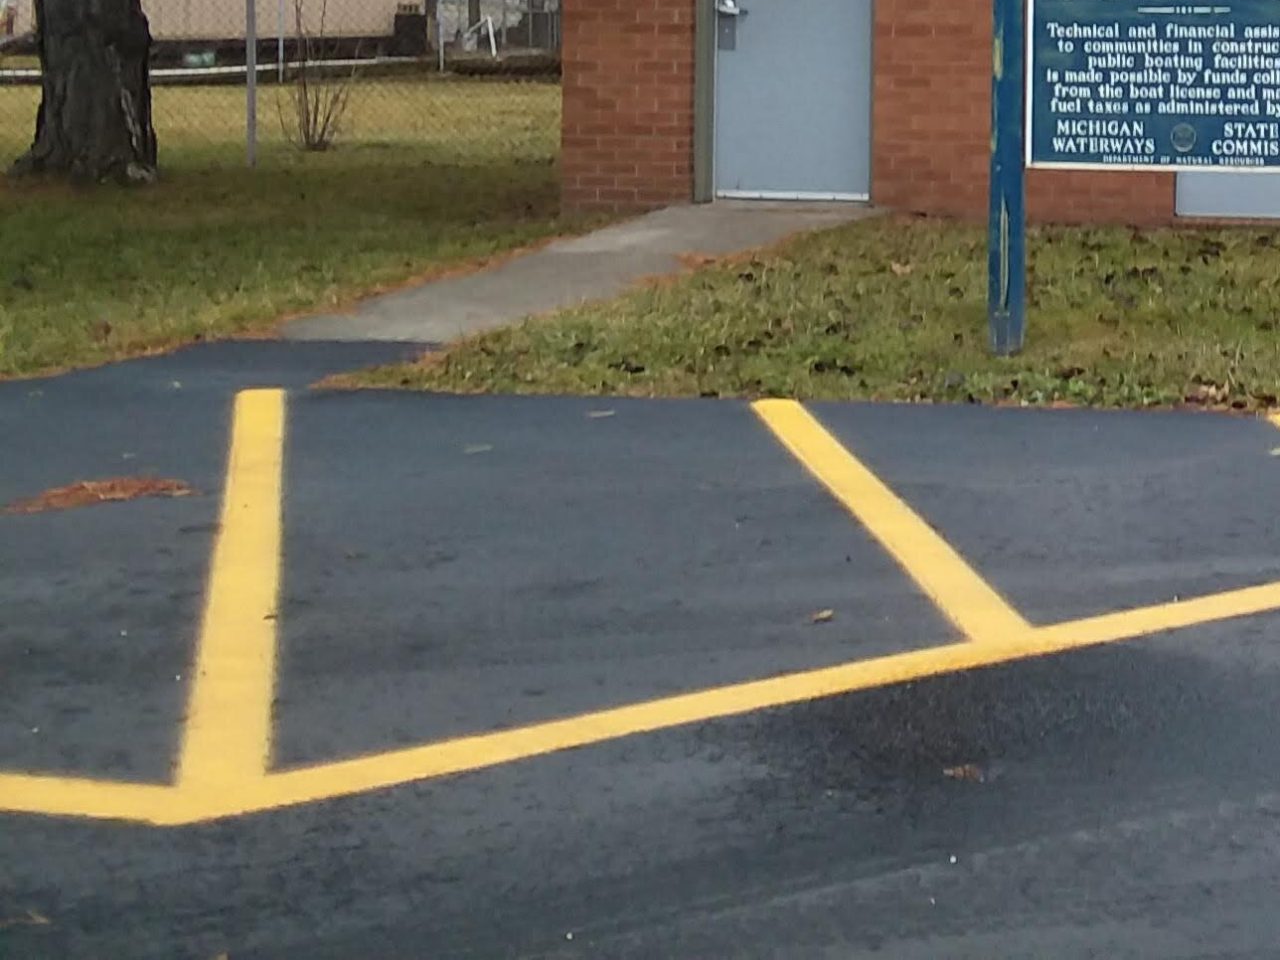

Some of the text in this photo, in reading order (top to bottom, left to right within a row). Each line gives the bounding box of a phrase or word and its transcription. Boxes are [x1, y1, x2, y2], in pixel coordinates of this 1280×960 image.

[1046, 23, 1119, 38] Technical
[1128, 23, 1157, 38] and
[1166, 23, 1235, 38] financial
[1057, 40, 1074, 53] to
[1083, 40, 1180, 54] communities
[1188, 40, 1203, 54] in
[1088, 54, 1135, 69] public
[1145, 54, 1203, 71] boating
[1047, 69, 1059, 83] is
[1064, 69, 1103, 83] made
[1110, 69, 1171, 86] possible
[1177, 69, 1197, 86] by
[1204, 69, 1247, 84] funds
[1054, 84, 1091, 98] from
[1099, 84, 1123, 98] the
[1130, 84, 1164, 99] boat
[1170, 84, 1221, 99] license
[1227, 85, 1256, 100] and
[1051, 99, 1081, 113] fuel
[1087, 100, 1128, 113] taxes
[1135, 101, 1151, 113] as
[1158, 99, 1259, 115] administered
[1056, 120, 1279, 139] MICHIGAN STATE
[1052, 137, 1155, 154] WATERWAYS
[1103, 155, 1154, 164] DEPARTMENT
[1176, 156, 1212, 165] NATURAL
